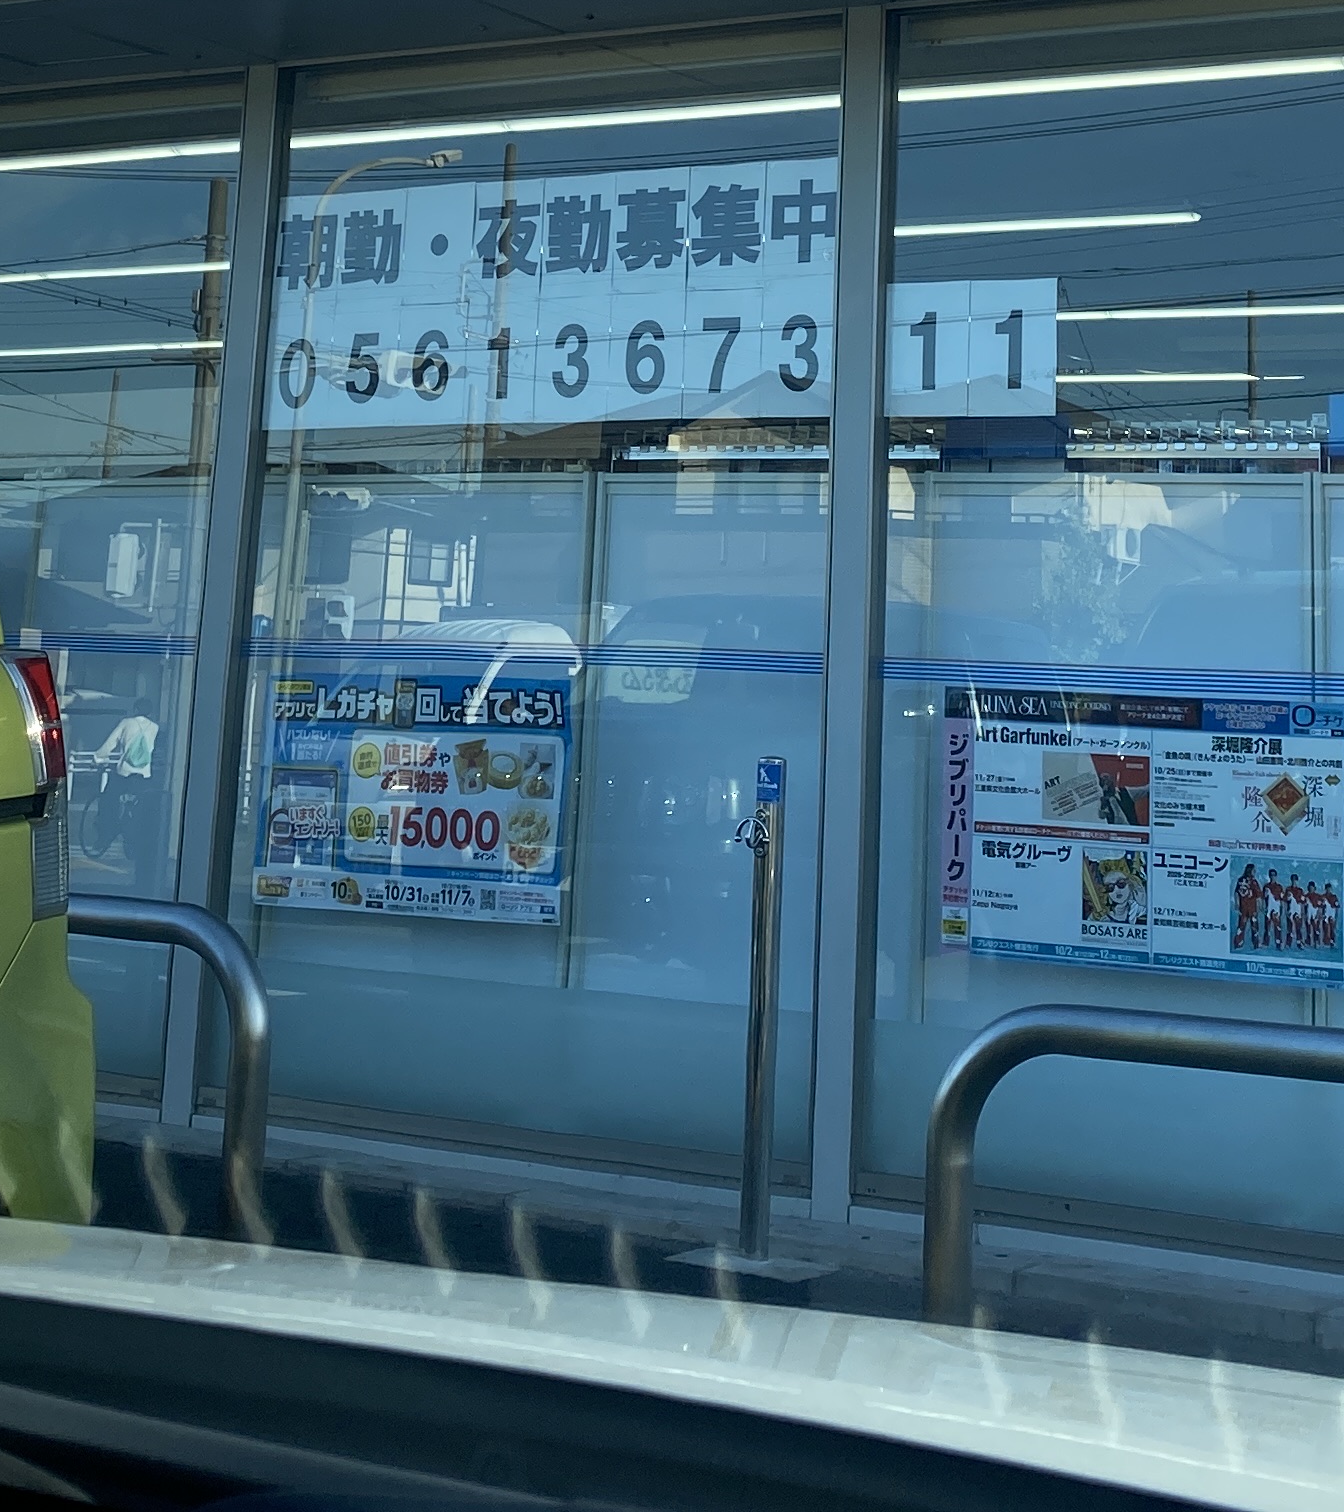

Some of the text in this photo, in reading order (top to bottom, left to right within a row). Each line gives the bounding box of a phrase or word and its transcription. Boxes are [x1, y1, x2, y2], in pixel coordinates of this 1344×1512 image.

[1000, 726, 1072, 748] Garfunkel
[946, 733, 970, 881] ジブリパーク
[390, 805, 501, 851] 15,000
[981, 840, 1072, 863] 電気グルーヴ
[1153, 852, 1229, 873] ユニコーン
[1081, 923, 1147, 940] BOSATS ARE
